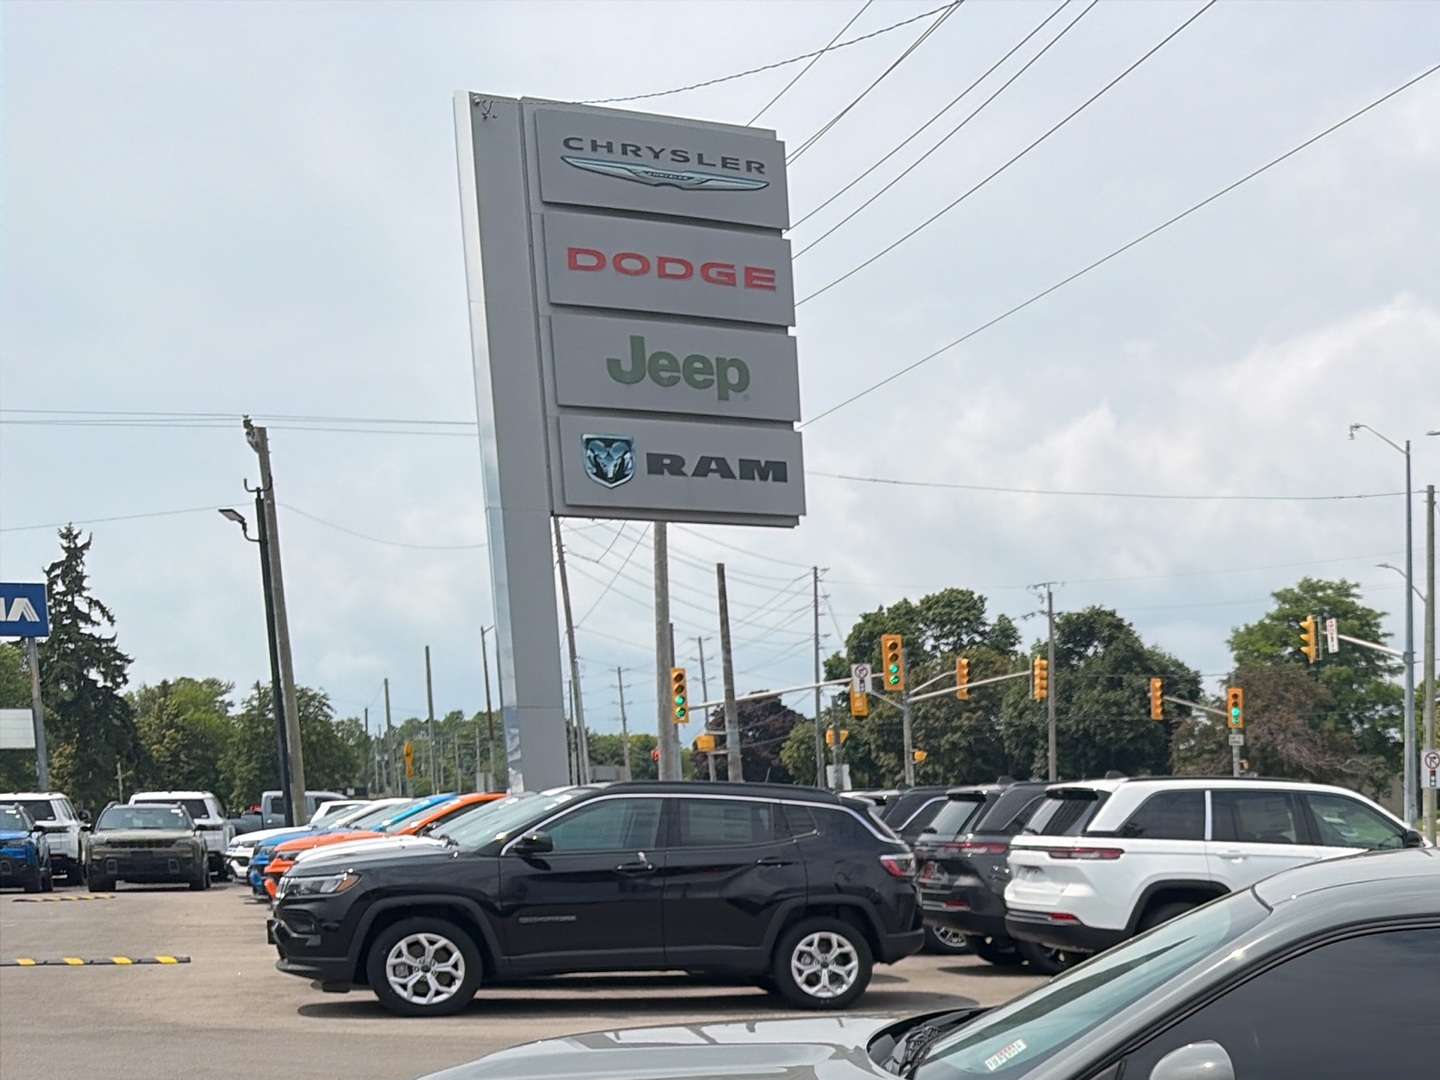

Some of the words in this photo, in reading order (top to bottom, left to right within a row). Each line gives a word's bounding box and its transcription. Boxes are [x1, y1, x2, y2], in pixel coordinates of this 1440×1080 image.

[563, 137, 766, 174] CHRYSLER
[567, 247, 777, 291] DODGE
[606, 335, 750, 400] Jeep
[646, 453, 788, 483] RAM
